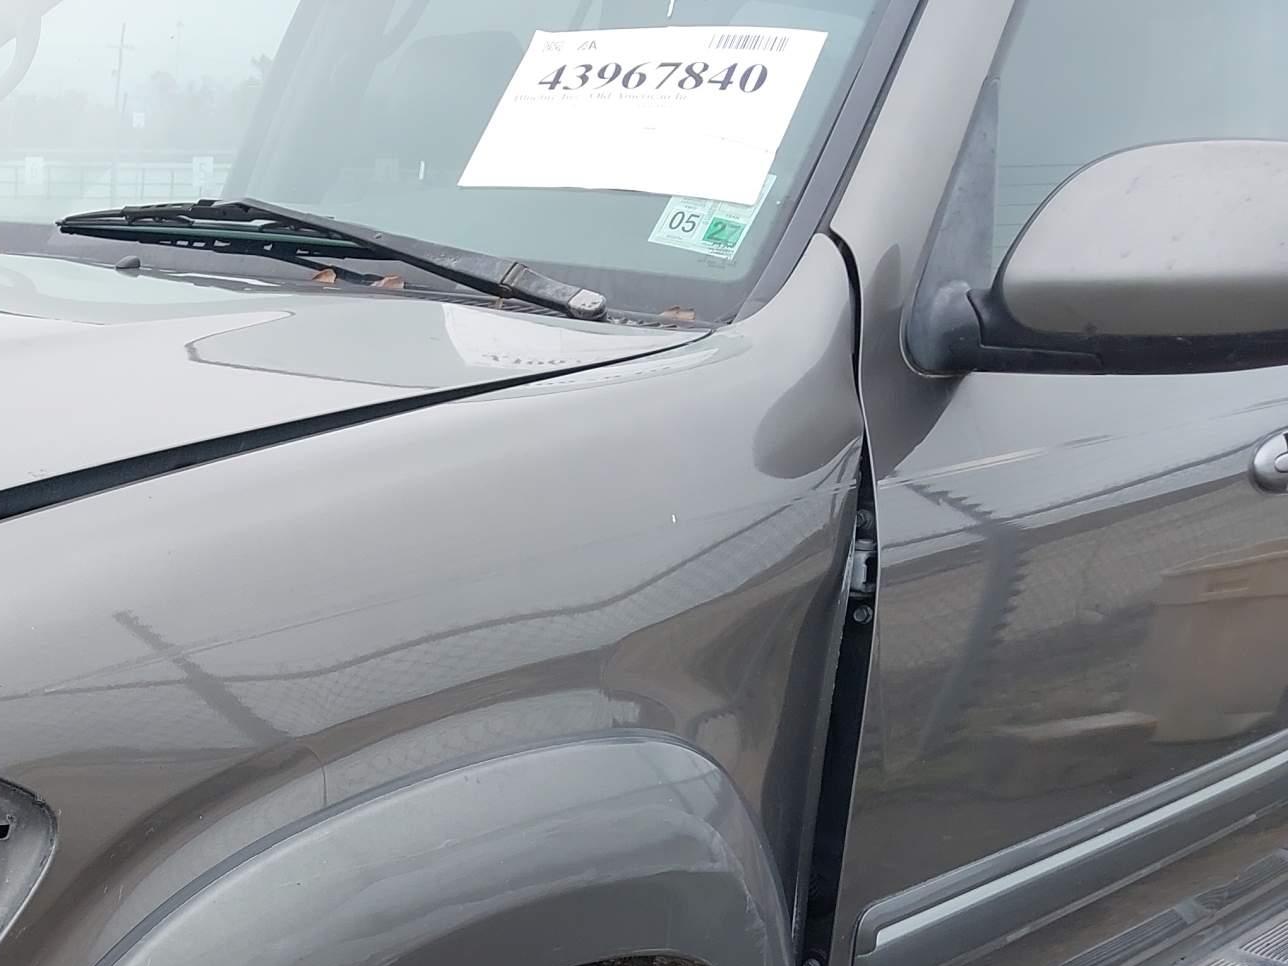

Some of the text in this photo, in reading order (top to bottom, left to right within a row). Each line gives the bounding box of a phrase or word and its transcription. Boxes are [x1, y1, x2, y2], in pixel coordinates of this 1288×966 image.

[538, 61, 768, 93] 43967840
[669, 211, 700, 233] 05
[707, 221, 741, 241] 27
